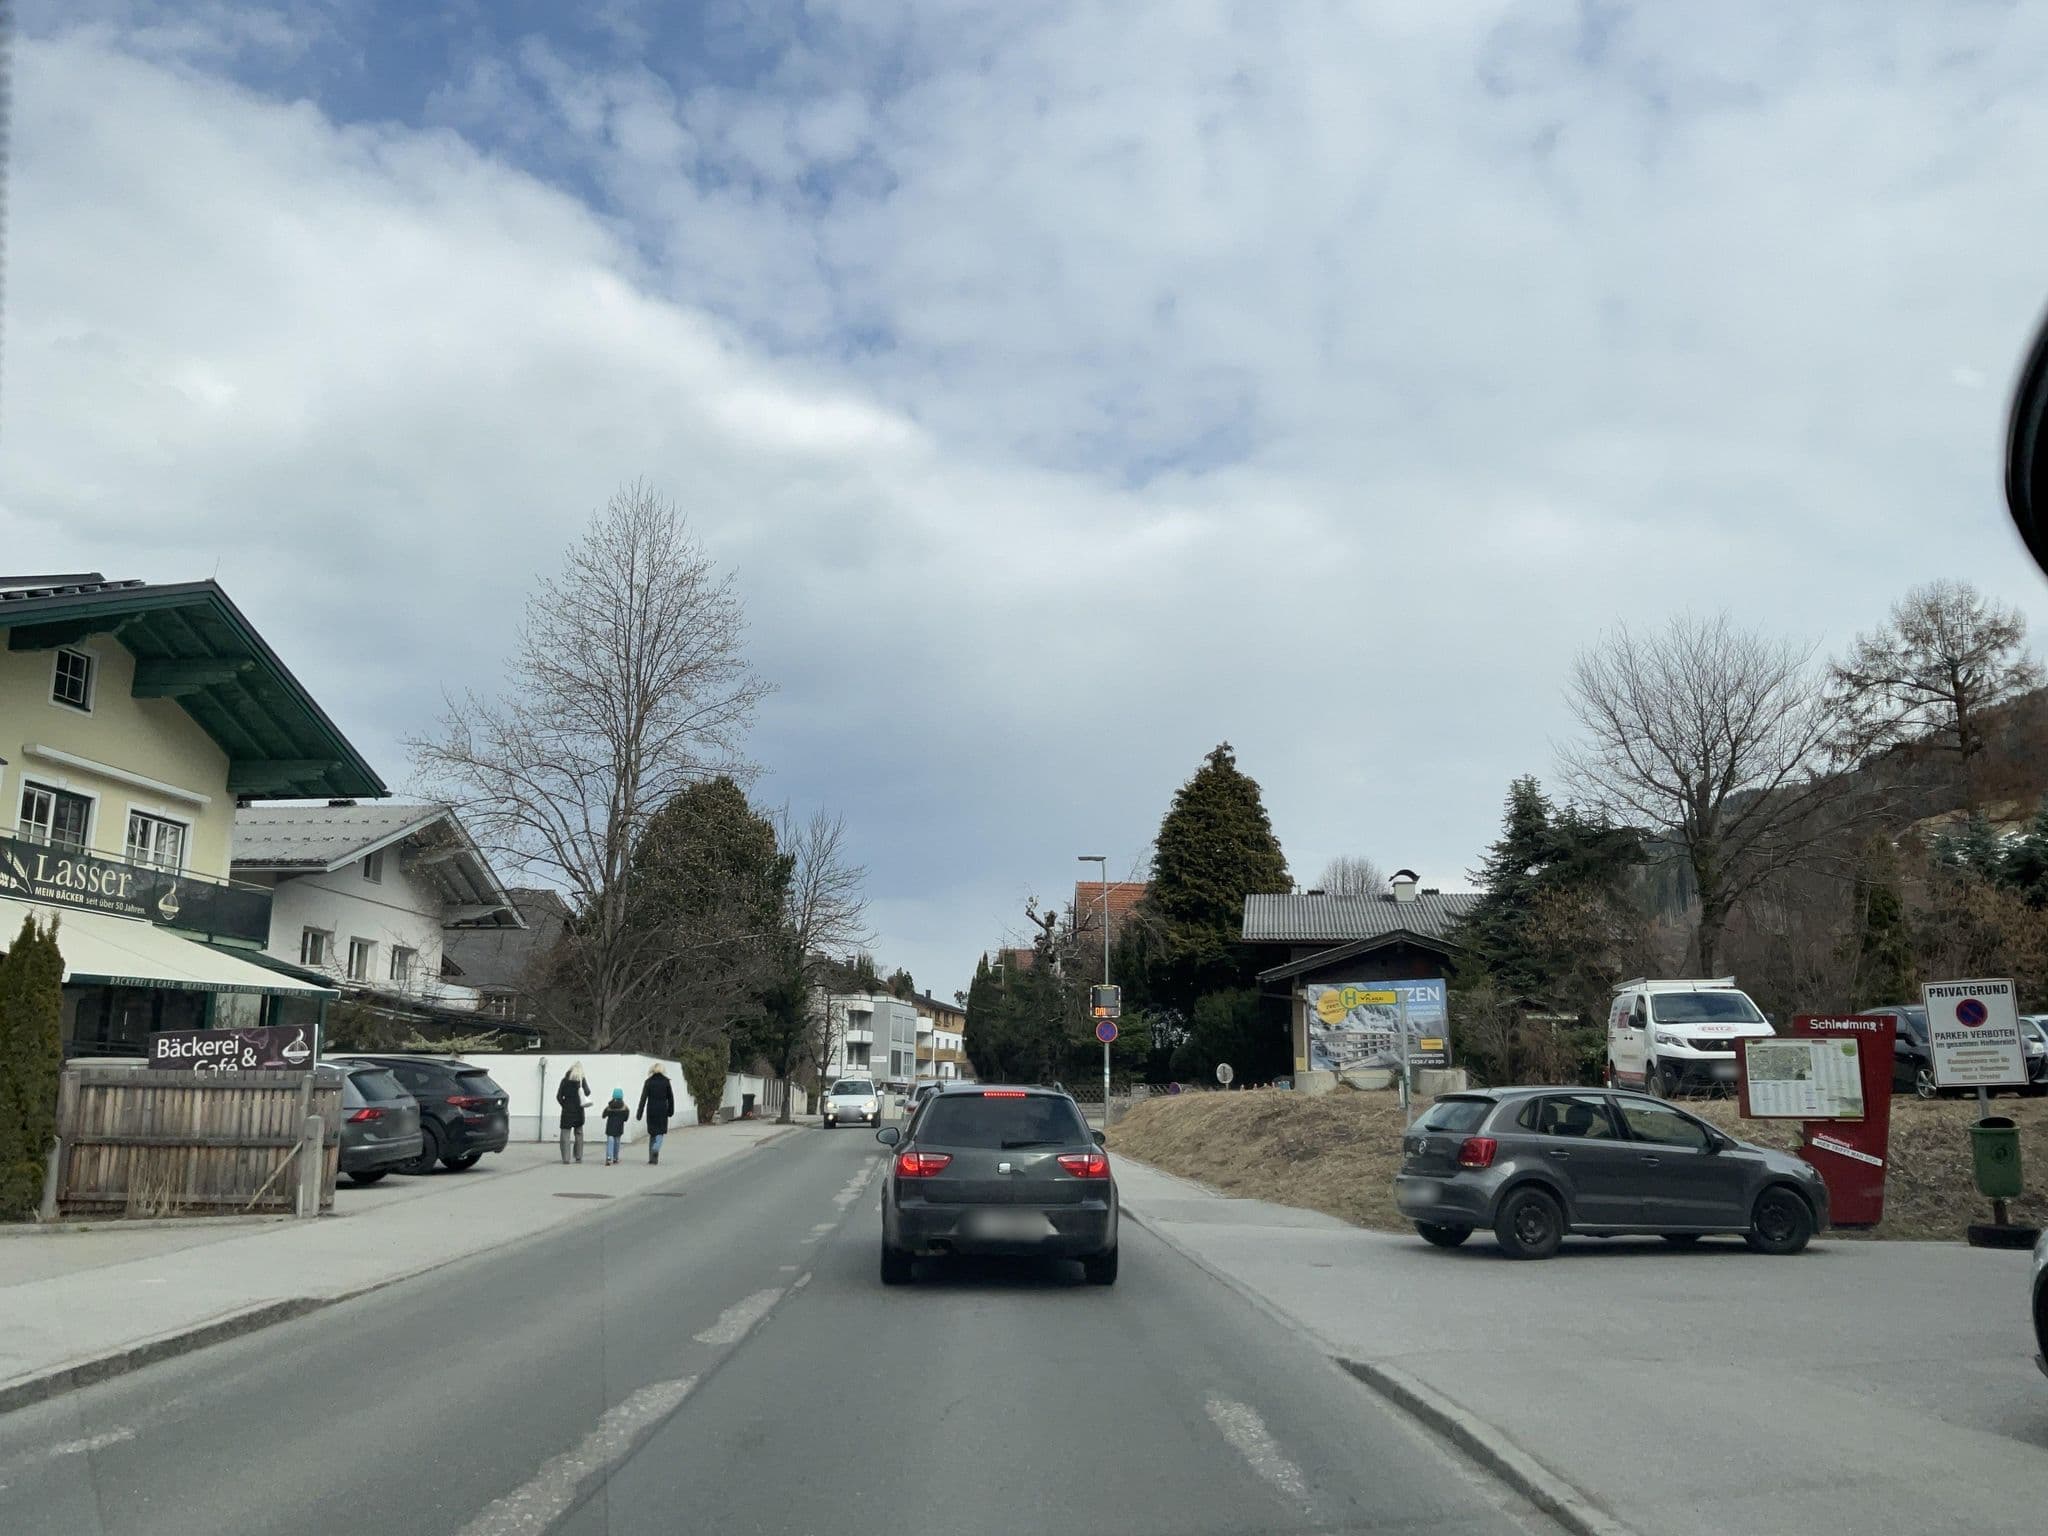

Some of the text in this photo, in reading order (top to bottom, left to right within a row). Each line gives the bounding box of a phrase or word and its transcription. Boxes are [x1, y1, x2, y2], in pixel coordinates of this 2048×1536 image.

[34, 853, 132, 898] Lasser
[34, 886, 55, 898] MEIN
[56, 889, 84, 904] BÄCKER
[86, 896, 98, 907] seit
[99, 898, 114, 909] über
[115, 901, 124, 911] 50
[1344, 990, 1357, 1005] H
[1928, 984, 2008, 998] PRIVATGRUND
[1935, 1028, 2015, 1041] PARKEN VERBOTEN
[157, 1034, 257, 1067] Bäckerei &
